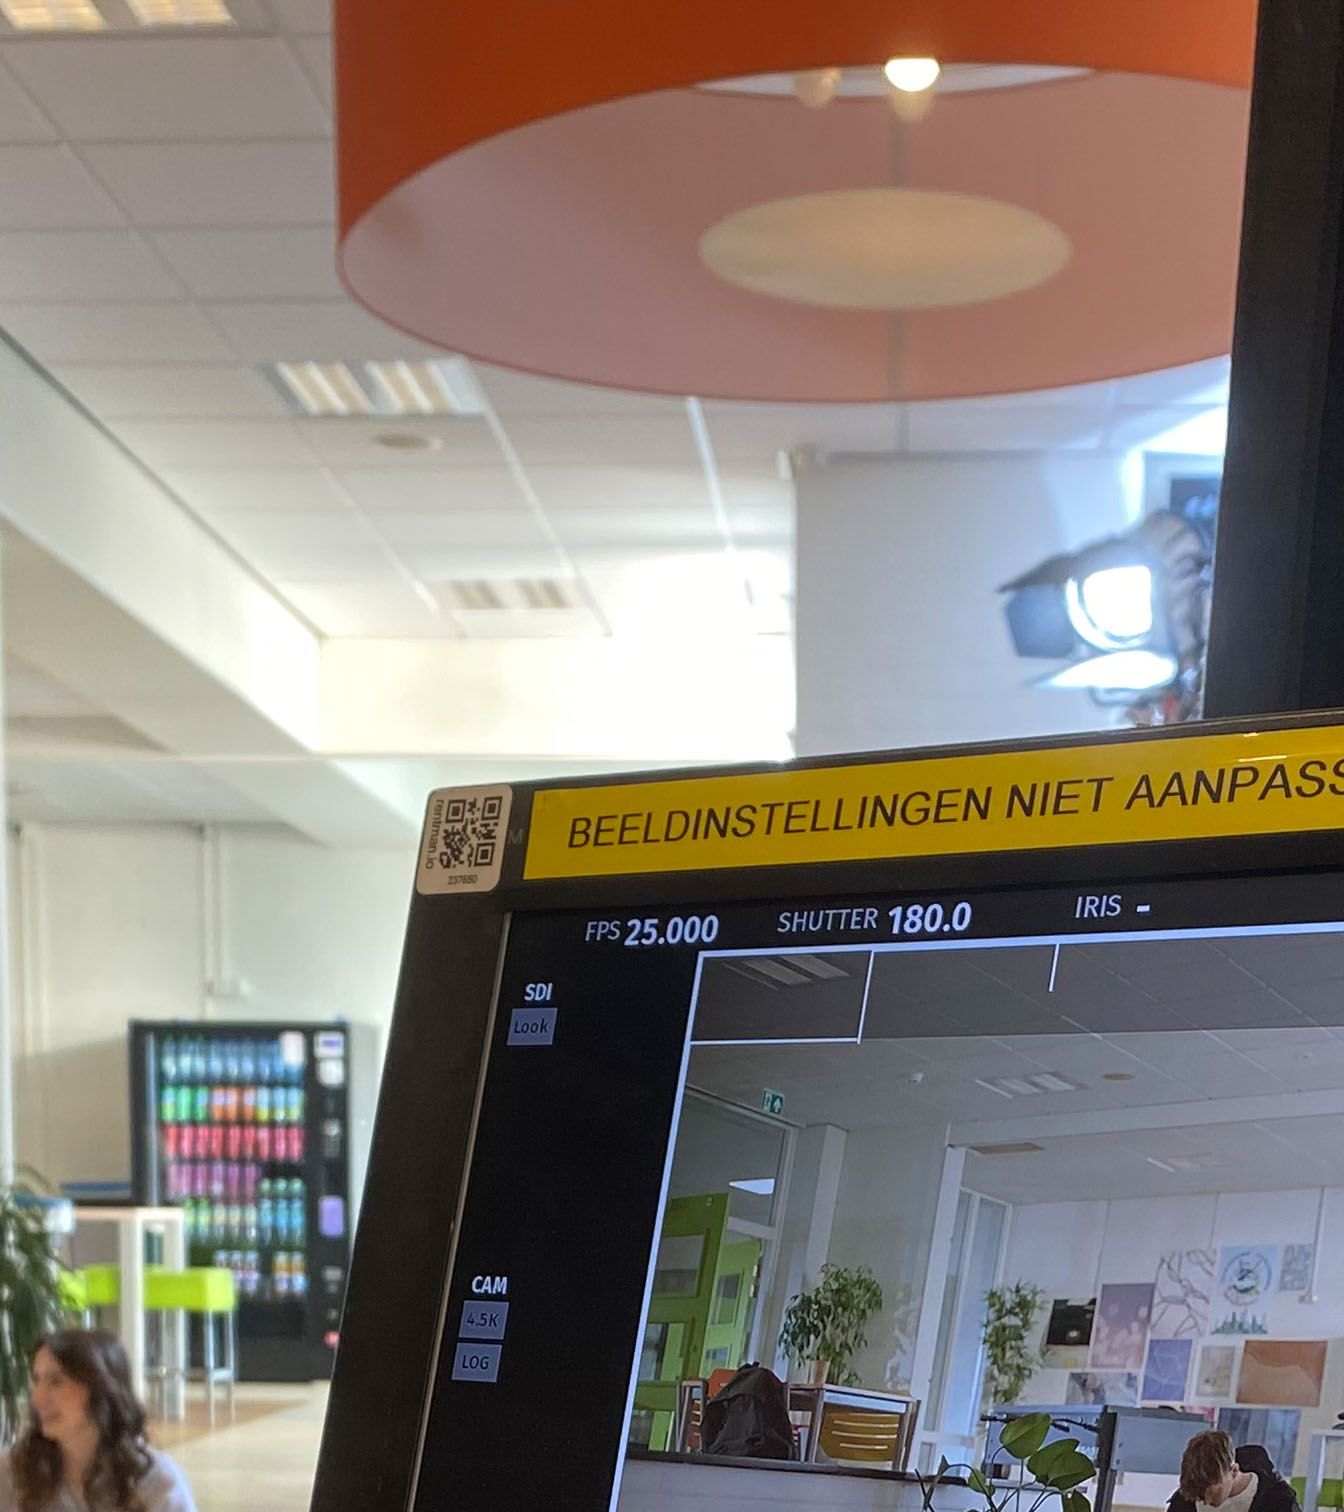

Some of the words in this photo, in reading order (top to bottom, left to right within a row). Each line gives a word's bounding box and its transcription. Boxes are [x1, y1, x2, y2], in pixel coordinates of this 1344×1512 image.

[567, 787, 993, 848] BEELDINSTELLINGEN
[1006, 777, 1114, 817] NIET
[425, 799, 445, 870] rentman.io
[1075, 895, 1122, 918] IRIS
[777, 908, 878, 933] SHUTTER
[888, 902, 973, 934] 180.0
[585, 921, 621, 942] FPS
[624, 915, 720, 946] 25.000
[524, 982, 553, 1001] SDI
[514, 1018, 549, 1034] Look
[472, 1276, 508, 1295] CAM
[467, 1312, 499, 1327] 4.5K
[462, 1355, 490, 1370] LOG
